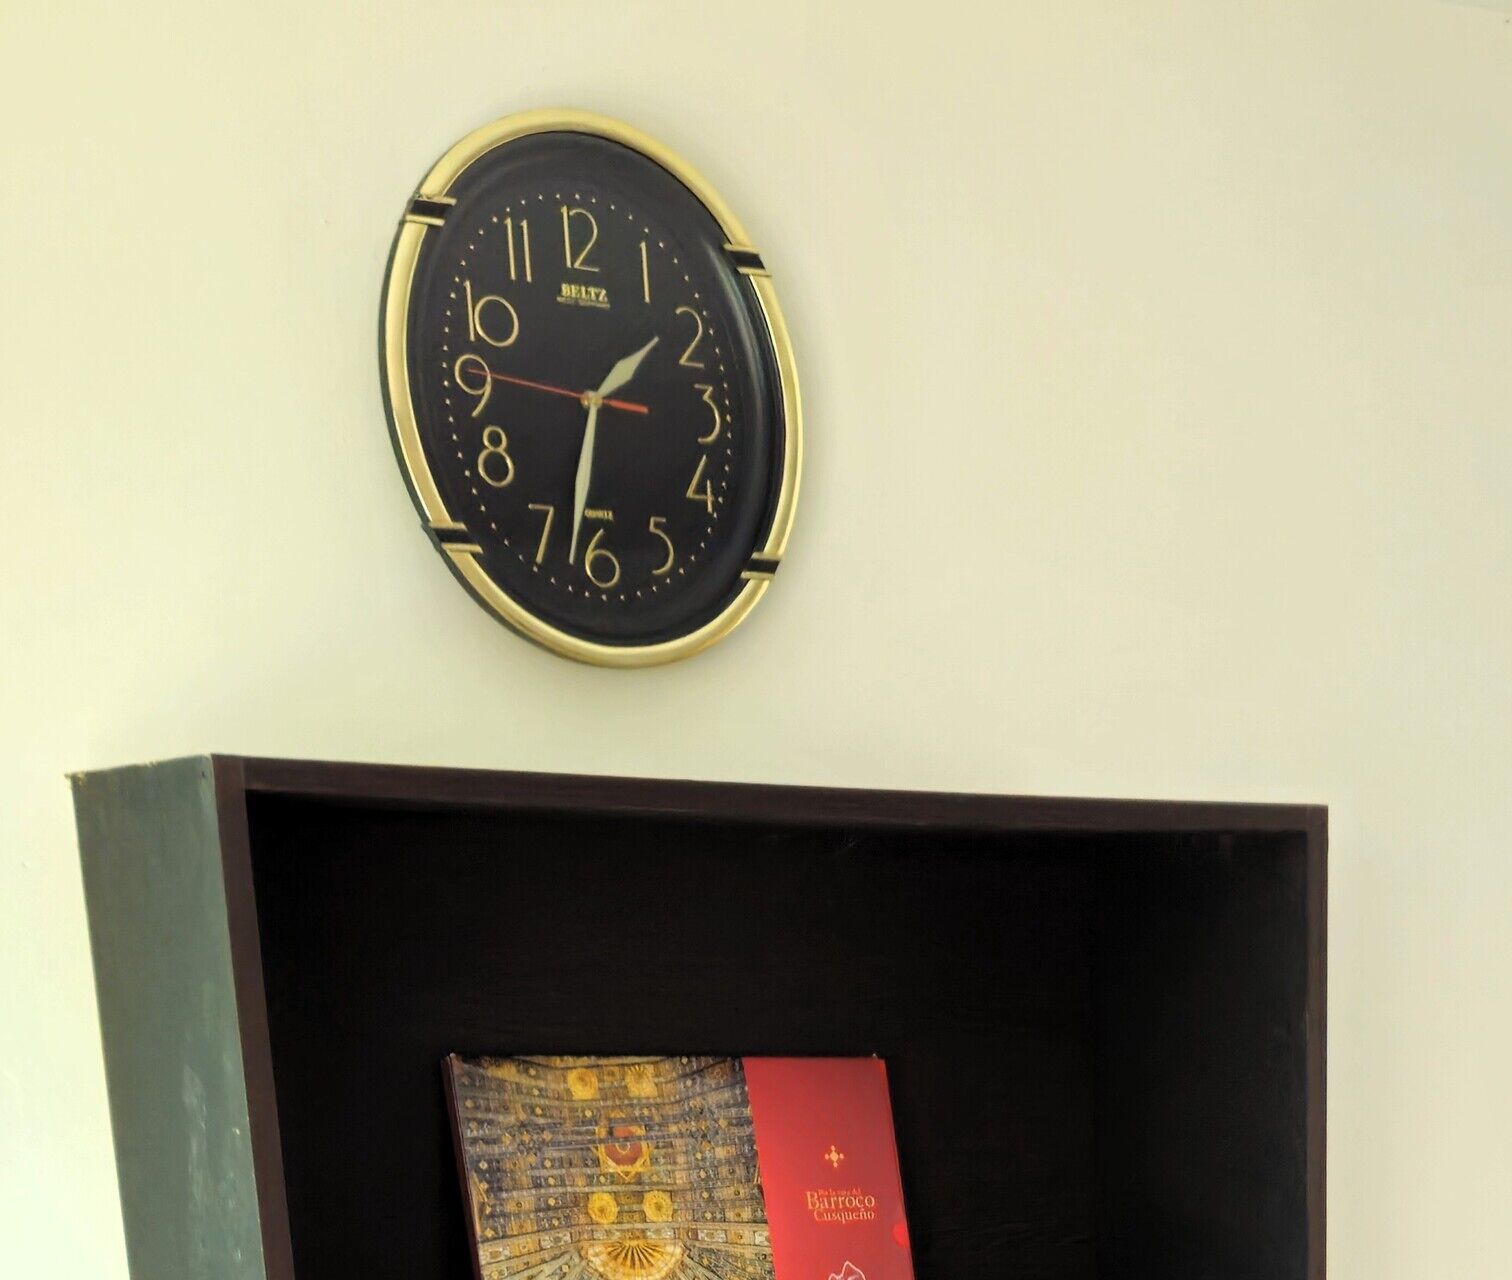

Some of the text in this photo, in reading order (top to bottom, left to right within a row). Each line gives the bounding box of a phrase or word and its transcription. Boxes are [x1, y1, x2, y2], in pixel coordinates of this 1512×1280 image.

[504, 217, 532, 283] 11
[560, 204, 599, 272] 12
[639, 240, 650, 303] 1
[464, 280, 519, 347] 10
[675, 306, 705, 368] 2
[454, 353, 492, 418] 9
[694, 383, 721, 443] 3
[477, 425, 515, 488] 8
[686, 454, 714, 514] 4
[528, 503, 555, 565] 7
[584, 528, 620, 588] 6
[648, 517, 674, 575] 5
[806, 1191, 875, 1210] Barroco
[813, 1208, 875, 1224] Cusqueño
